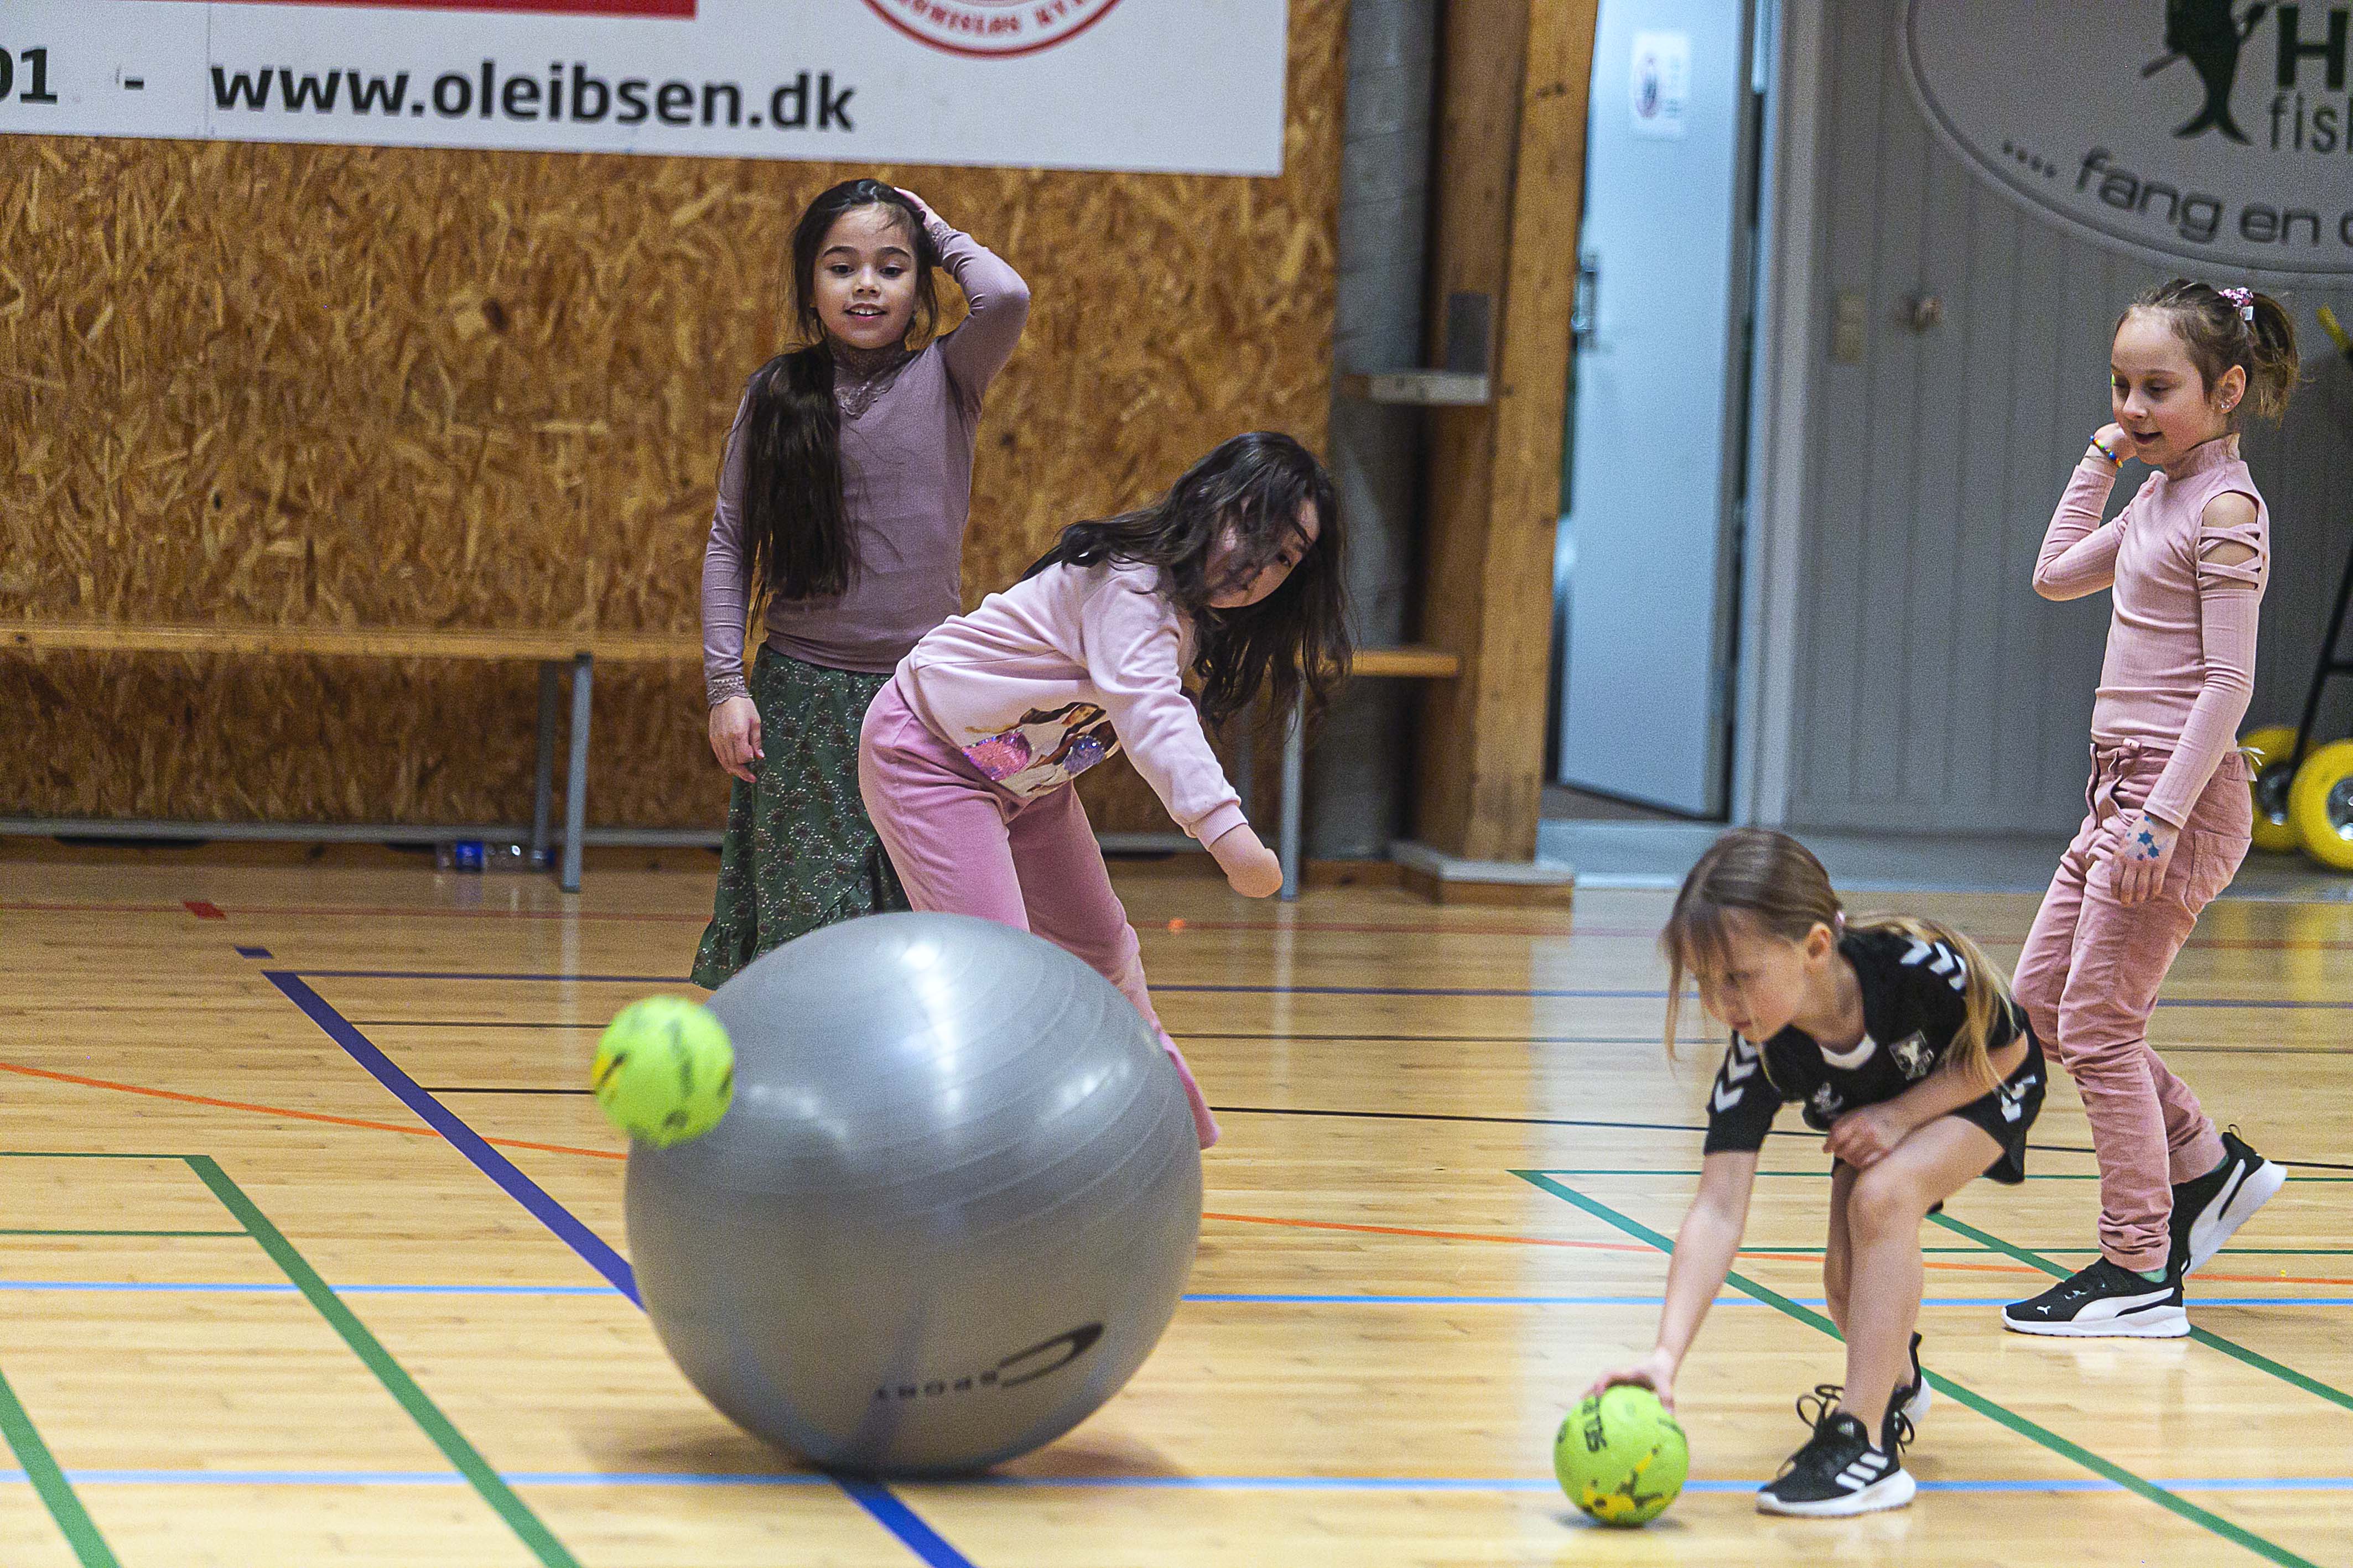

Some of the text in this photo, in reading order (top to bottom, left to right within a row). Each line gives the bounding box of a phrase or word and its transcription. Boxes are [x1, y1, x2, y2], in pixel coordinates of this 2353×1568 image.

[210, 61, 856, 132] www.oleibsen.dk
[2076, 146, 2223, 244] fang
[2239, 204, 2322, 246] en
